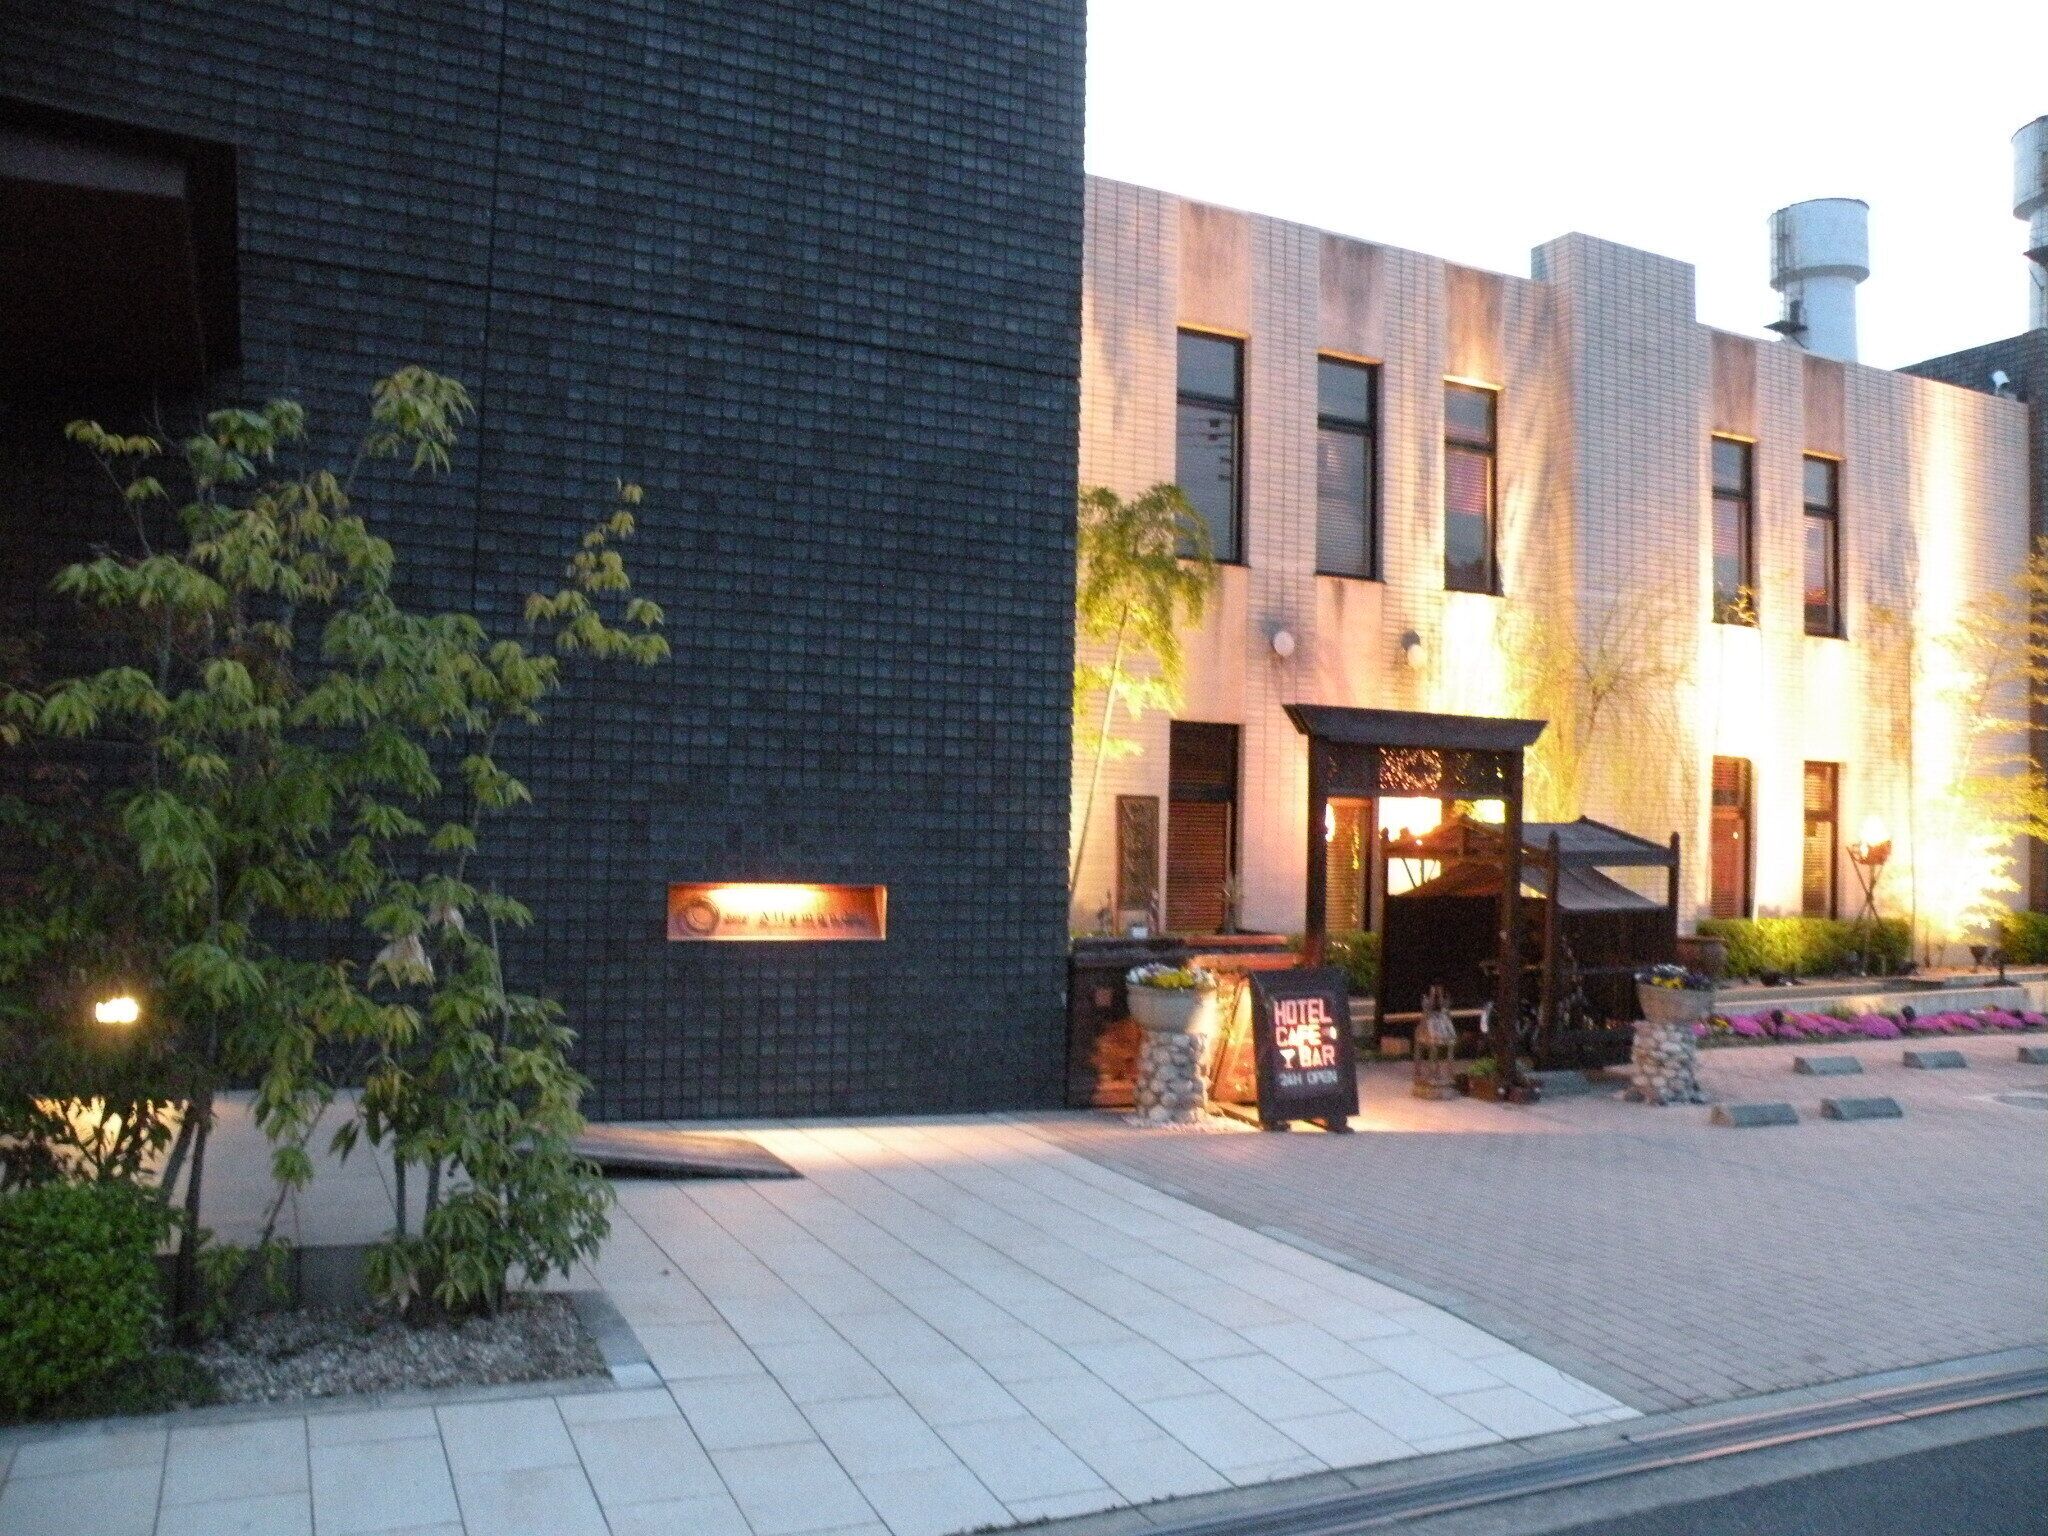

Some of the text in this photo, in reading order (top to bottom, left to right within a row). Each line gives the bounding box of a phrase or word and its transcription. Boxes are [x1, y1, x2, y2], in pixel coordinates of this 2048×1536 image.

[1274, 998, 1332, 1026] HOTEL
[1275, 1023, 1321, 1047] CAFE
[1298, 1045, 1336, 1068] BAR
